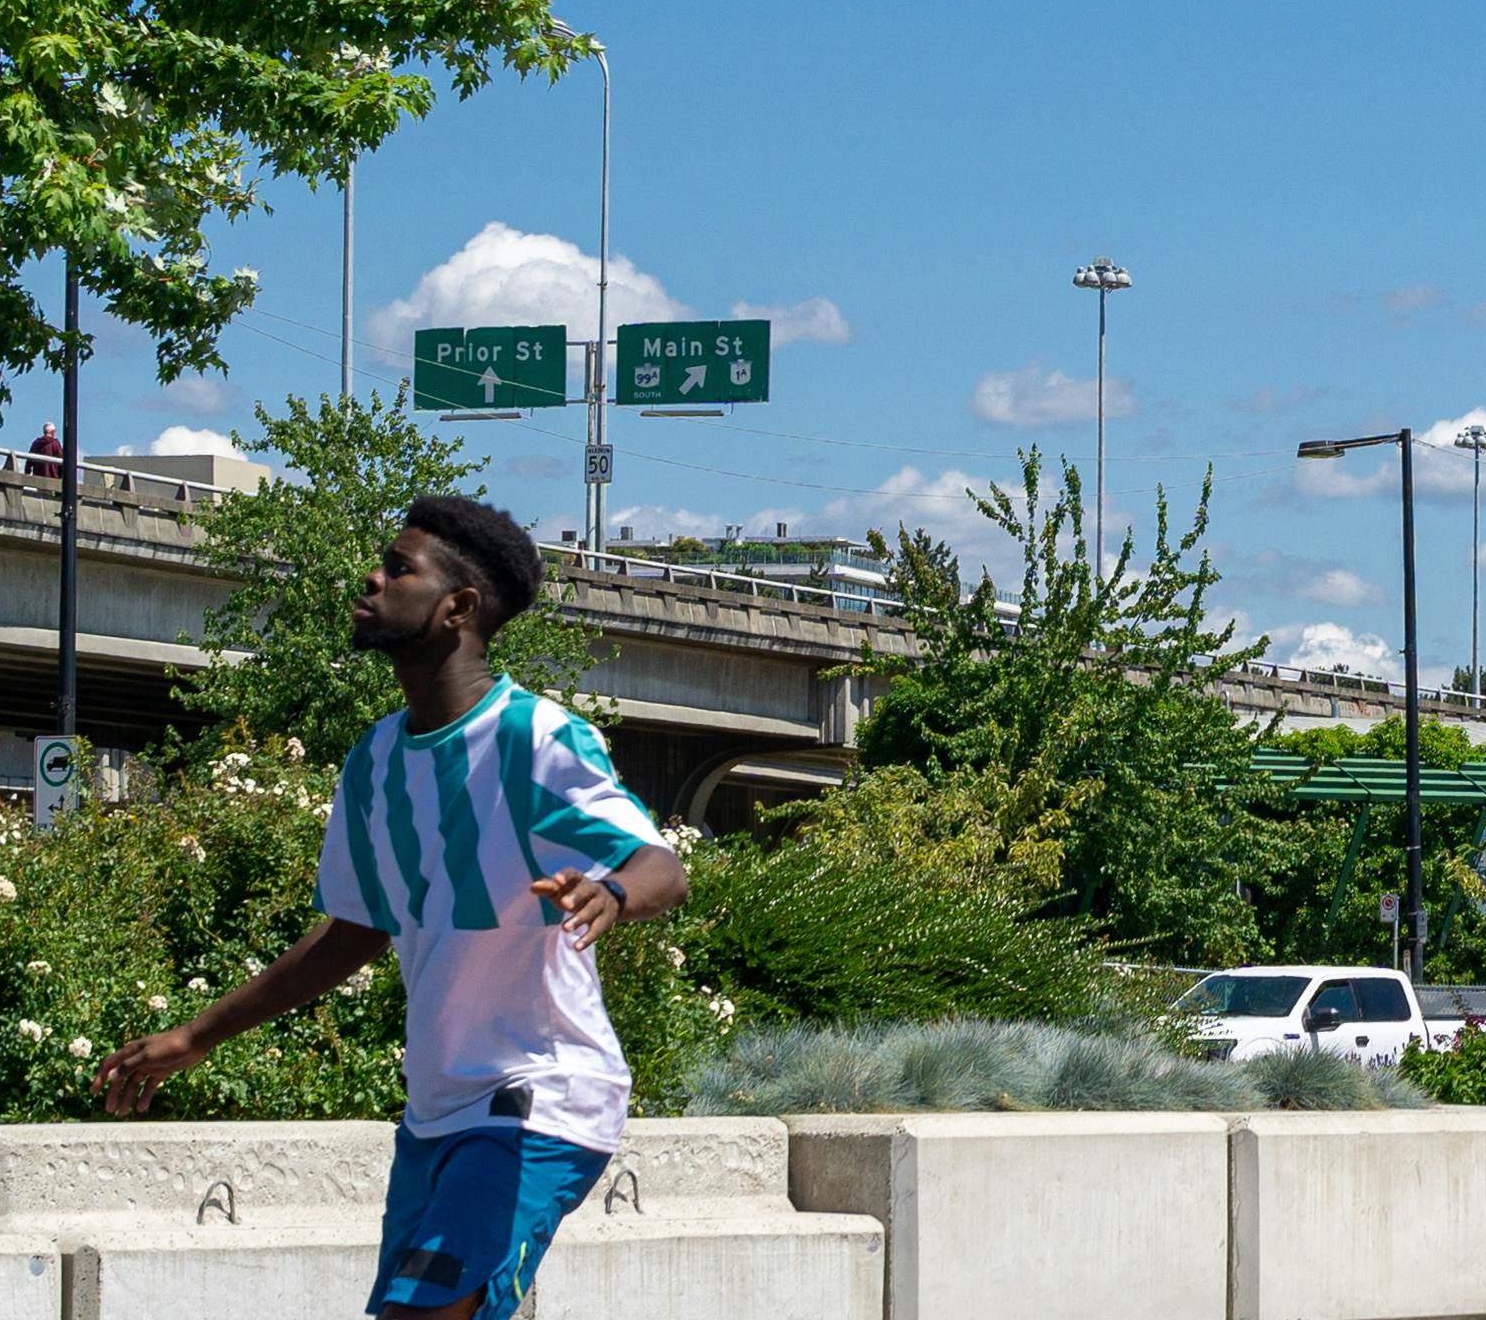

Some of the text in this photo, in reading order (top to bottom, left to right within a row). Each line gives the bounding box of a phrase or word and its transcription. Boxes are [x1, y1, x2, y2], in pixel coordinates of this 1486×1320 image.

[437, 341, 543, 363] Prior St
[644, 336, 743, 357] Main St
[636, 371, 658, 384] 99A
[736, 369, 746, 381] 1A
[589, 455, 608, 474] 50
